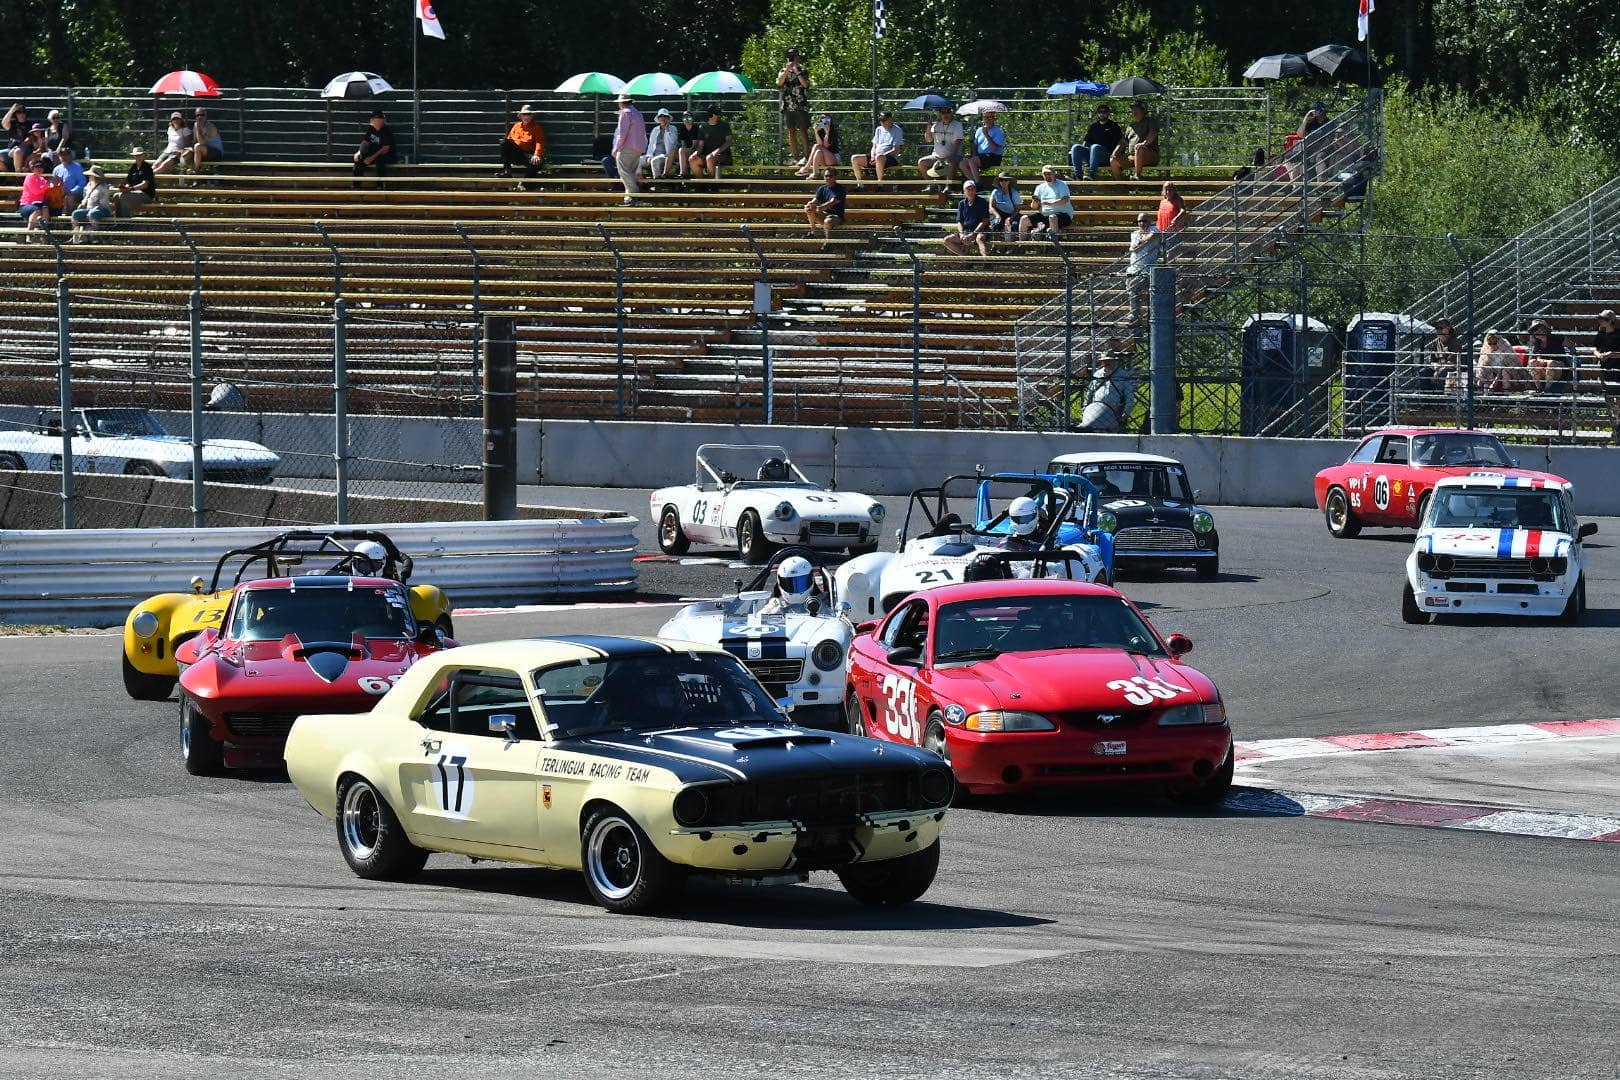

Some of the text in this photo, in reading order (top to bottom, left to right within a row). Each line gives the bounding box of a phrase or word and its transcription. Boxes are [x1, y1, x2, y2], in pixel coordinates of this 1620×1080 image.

[805, 495, 838, 503] 03
[1350, 492, 1361, 508] BS
[1375, 480, 1388, 505] 06
[692, 499, 708, 524] 03
[915, 568, 954, 584] 21
[192, 608, 225, 623] 13
[357, 674, 402, 696] 6
[540, 757, 651, 783] TERLINGUA RACING TEAM
[437, 754, 468, 812] 17
